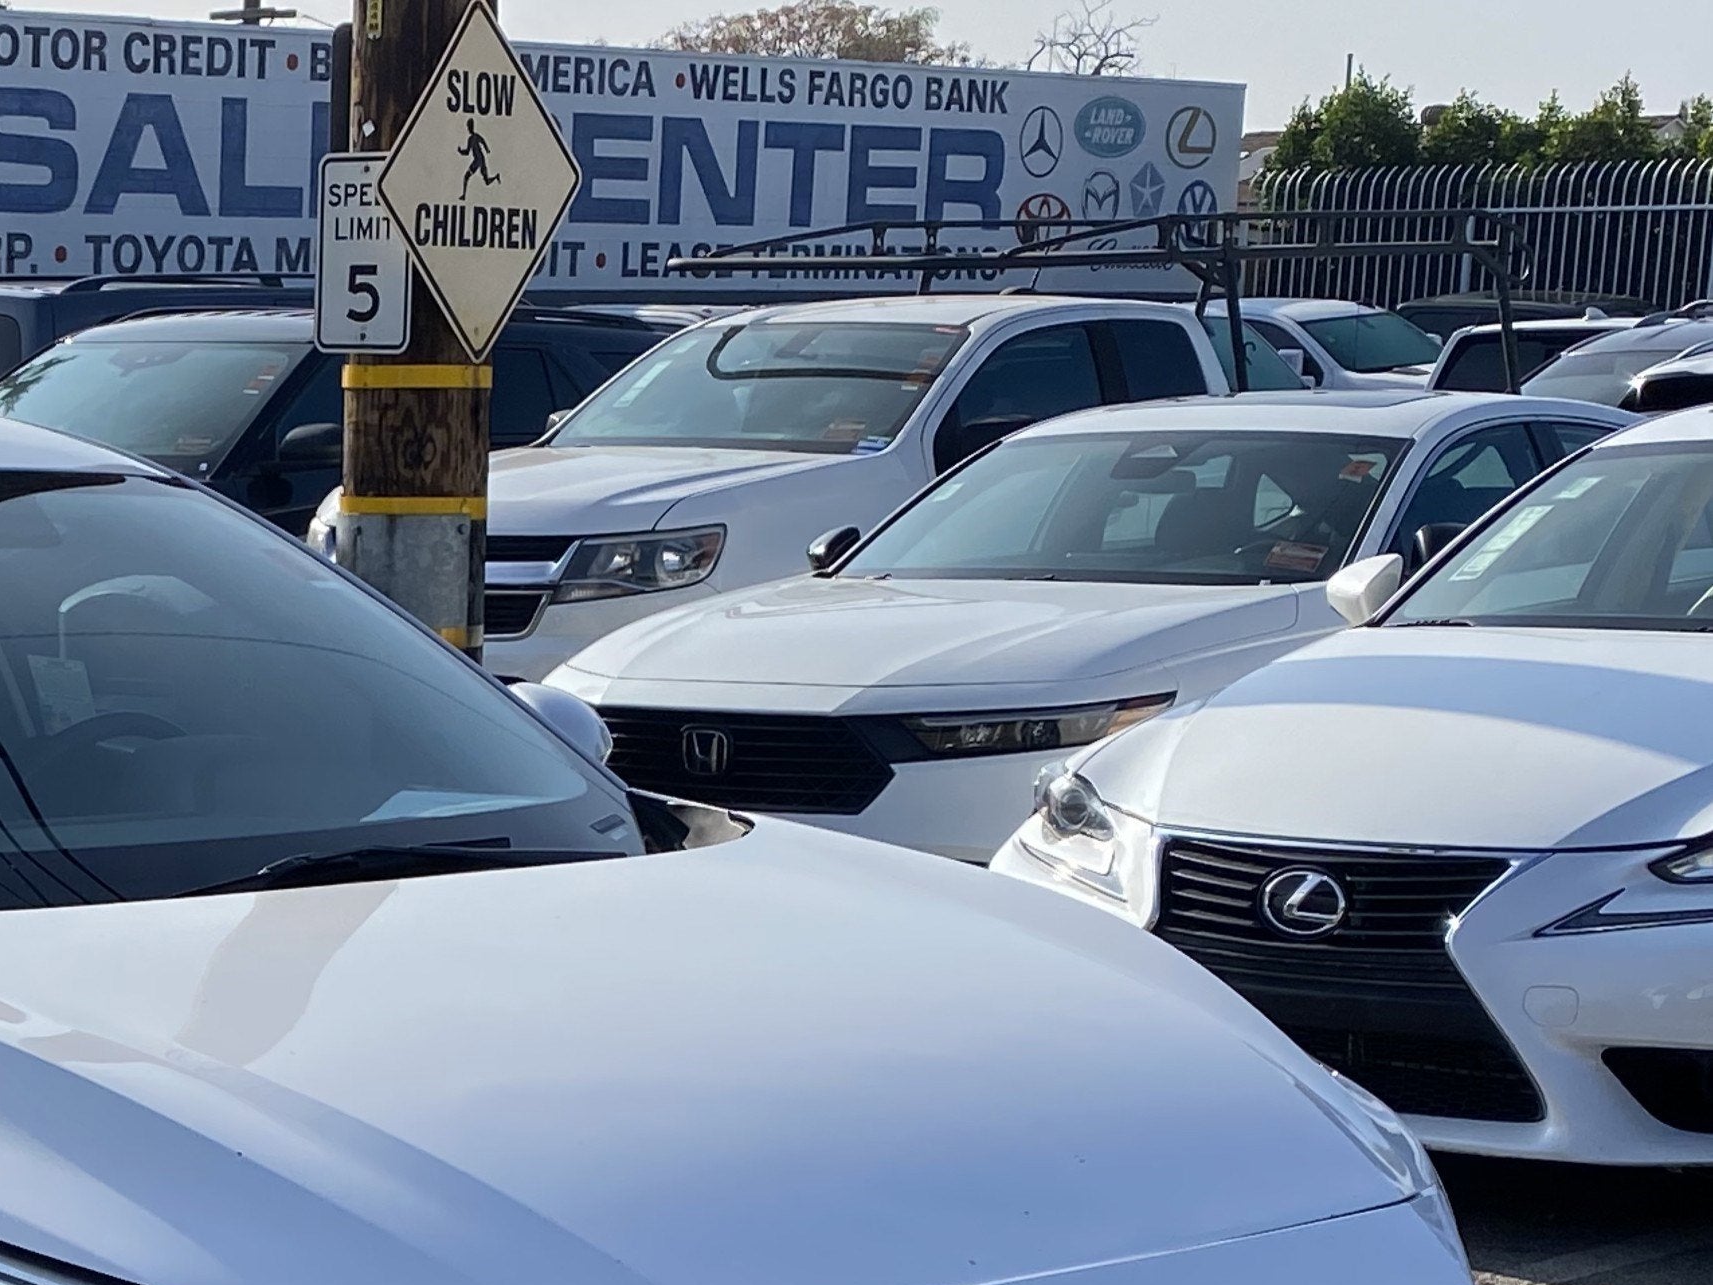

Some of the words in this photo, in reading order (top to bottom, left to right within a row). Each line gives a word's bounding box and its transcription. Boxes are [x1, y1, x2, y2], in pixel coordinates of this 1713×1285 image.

[123, 30, 276, 80] CREDIT
[520, 53, 657, 98] MERICA
[689, 62, 797, 106] WELLS
[807, 69, 914, 112] FARGO
[925, 75, 1010, 114] BANK
[446, 68, 517, 117] SLOW
[1090, 107, 1125, 125] LAND
[1091, 126, 1135, 146] ROVER
[328, 182, 381, 208] SPE
[550, 112, 1006, 231] ENTER
[414, 202, 538, 251] CHILDREN
[85, 233, 259, 274] TOYOTA
[346, 264, 381, 323] 5
